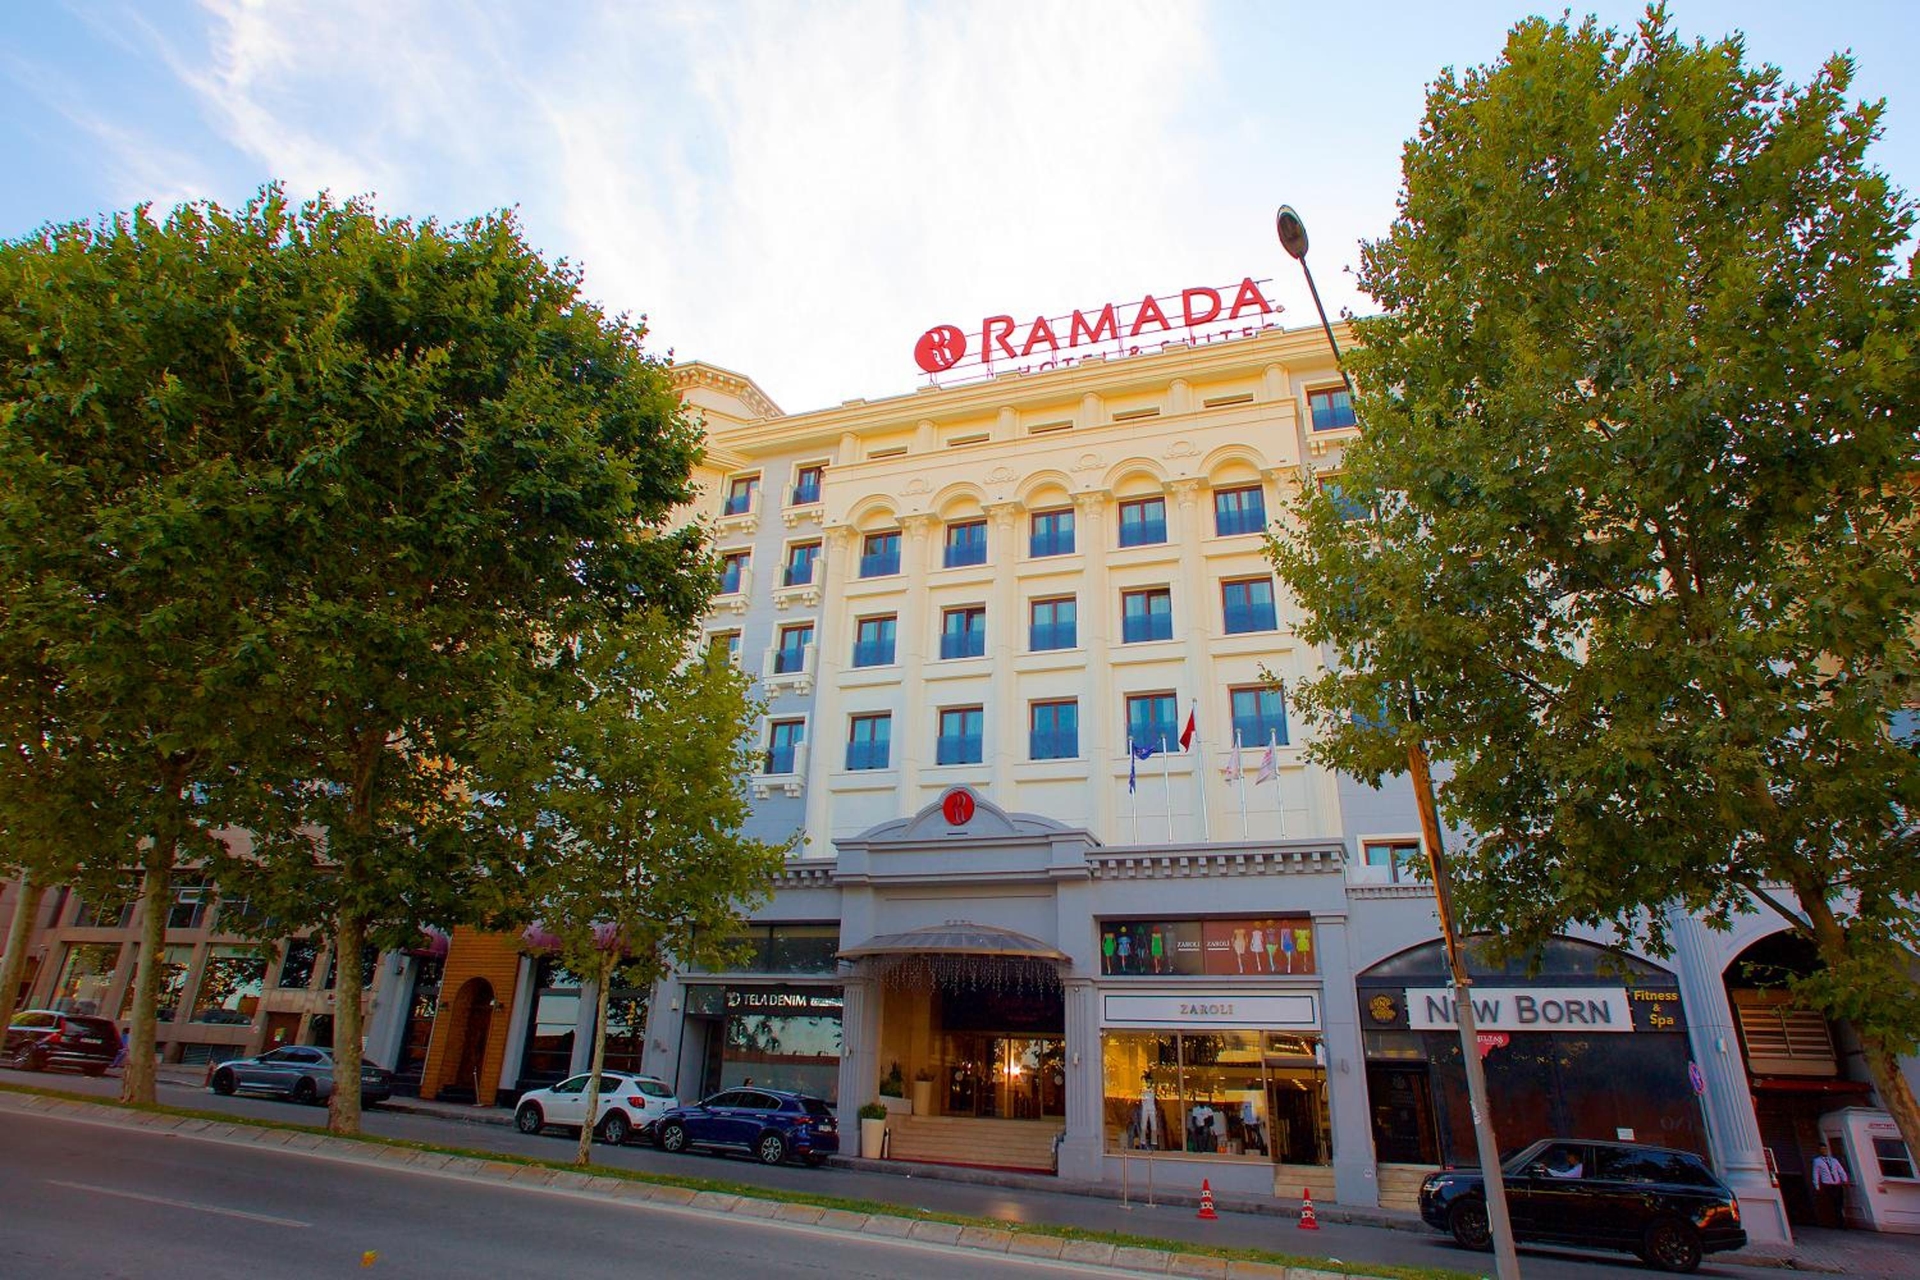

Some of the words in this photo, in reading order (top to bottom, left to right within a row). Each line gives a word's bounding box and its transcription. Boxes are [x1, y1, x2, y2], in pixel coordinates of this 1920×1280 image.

[981, 277, 1273, 362] RAMADA
[744, 994, 767, 1006] TELA
[1634, 990, 1678, 1001] Fitness
[1180, 1004, 1234, 1015] ZAROLI
[1426, 995, 1499, 1024] NW
[1515, 995, 1611, 1024] BORN
[1653, 1003, 1661, 1012] &
[1650, 1013, 1675, 1028] Spa
